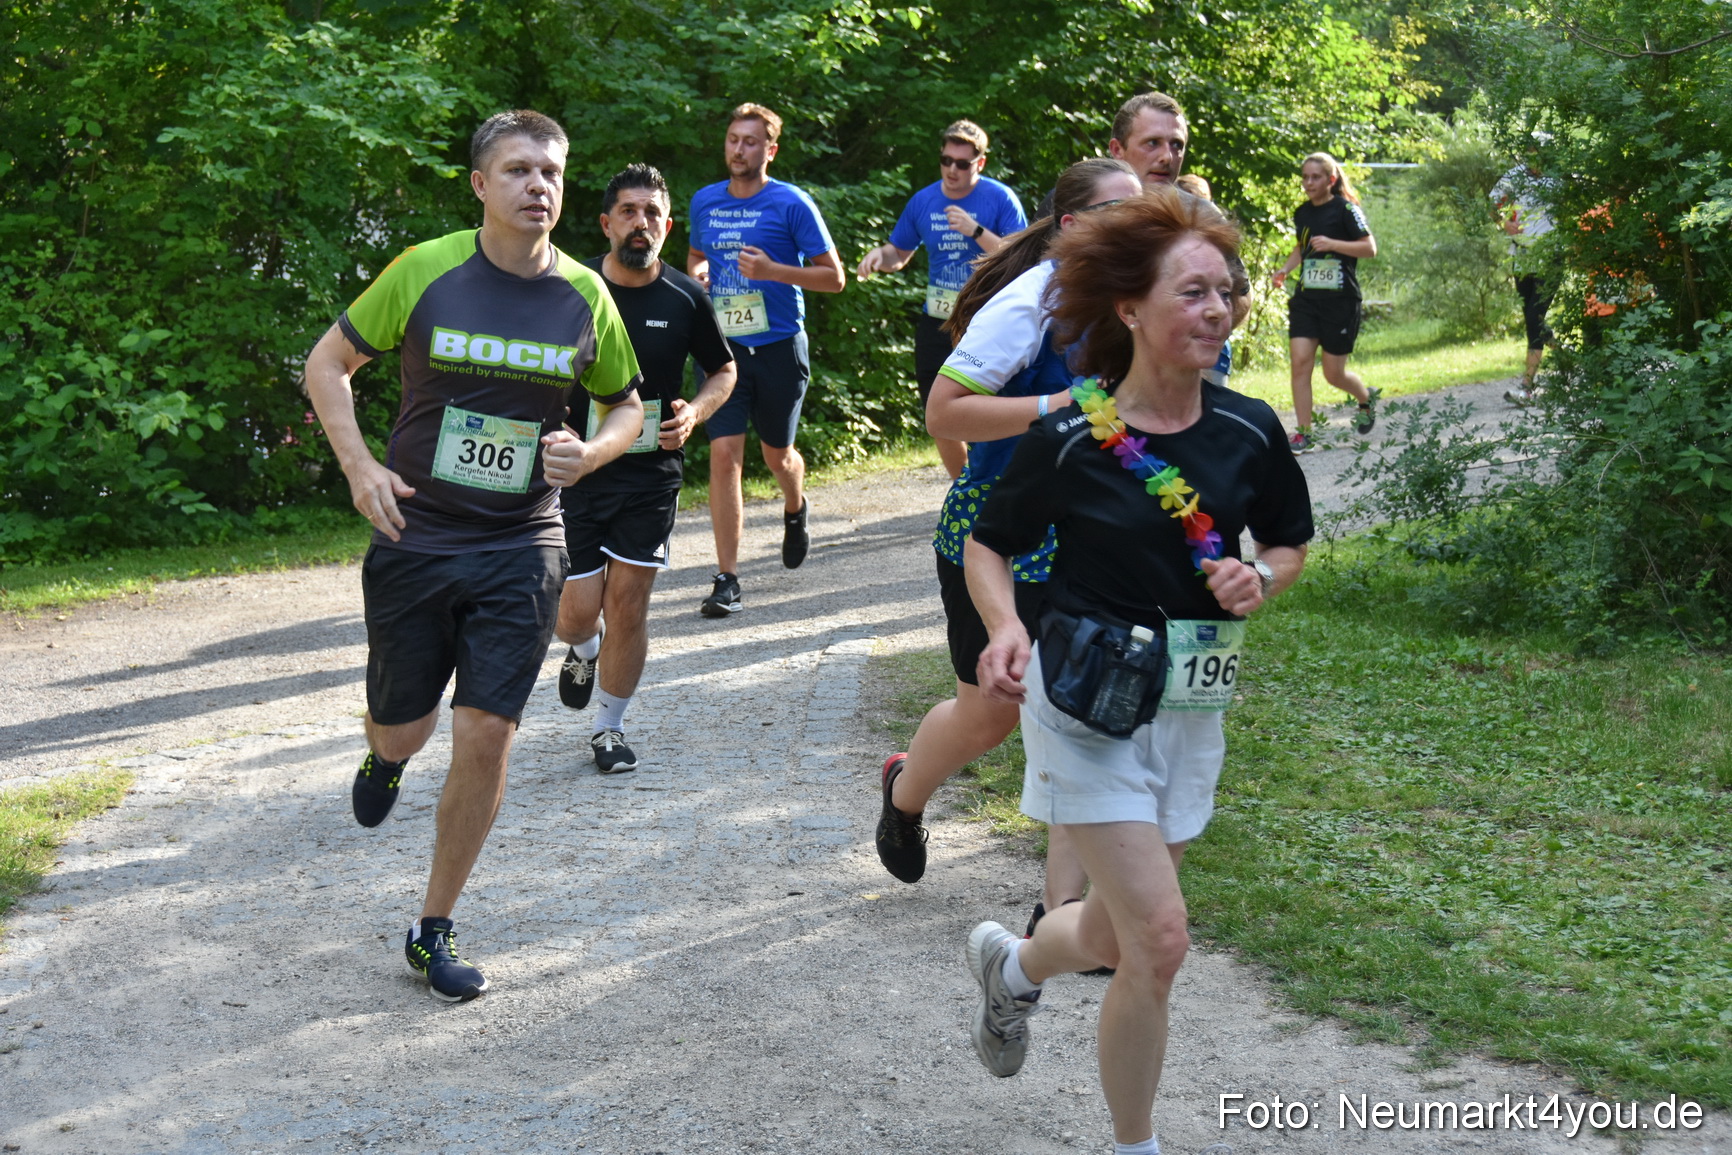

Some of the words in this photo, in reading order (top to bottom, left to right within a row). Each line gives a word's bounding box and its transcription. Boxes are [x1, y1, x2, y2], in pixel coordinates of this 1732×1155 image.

[709, 208, 732, 217] Wenn
[733, 210, 741, 218] es
[743, 208, 762, 218] beim
[942, 233, 964, 241] richtig
[712, 242, 746, 250] LAUFEN
[938, 242, 968, 251] LAUFEN
[1307, 270, 1334, 281] 1756
[935, 300, 954, 314] 72
[724, 308, 754, 325] 724
[646, 319, 669, 329] MEHMET
[432, 329, 575, 377] BOCK
[429, 359, 473, 374] inspired
[477, 366, 491, 378] by
[494, 370, 528, 382] smart
[458, 438, 515, 471] 306
[1183, 653, 1238, 689] 196
